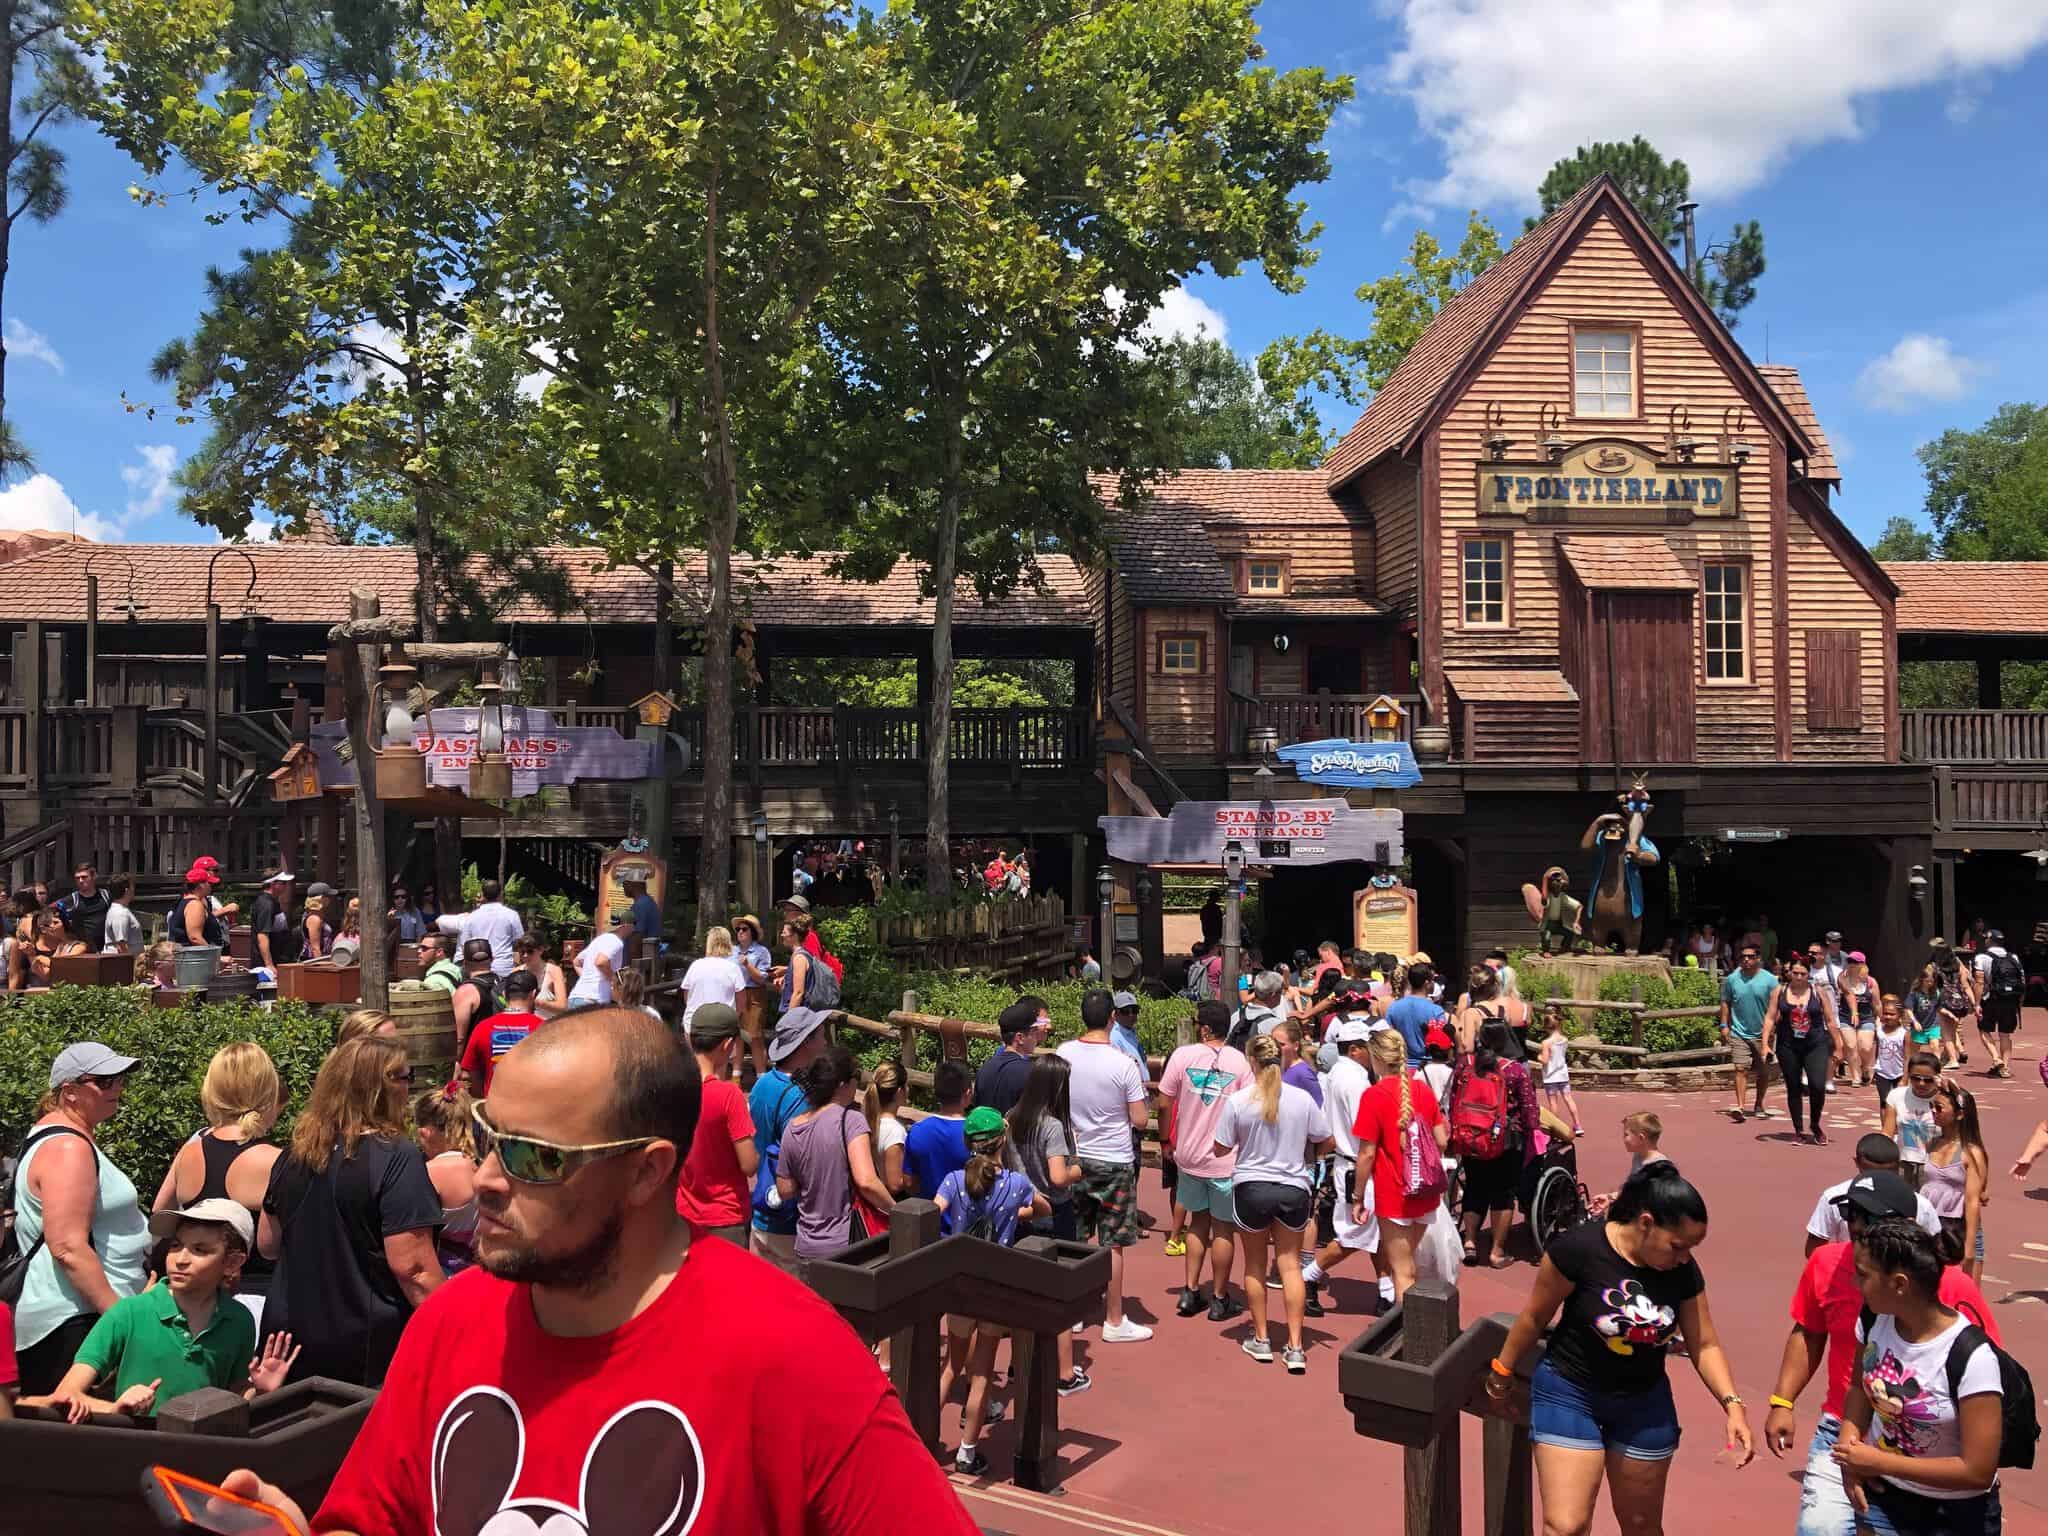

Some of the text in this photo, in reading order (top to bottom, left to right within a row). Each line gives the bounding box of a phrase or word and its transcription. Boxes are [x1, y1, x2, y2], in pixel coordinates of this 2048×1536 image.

[1494, 475, 1723, 505] FRONTIERLAND
[442, 758, 546, 768] ENNCE
[1226, 827, 1323, 838] ENTRANCE
